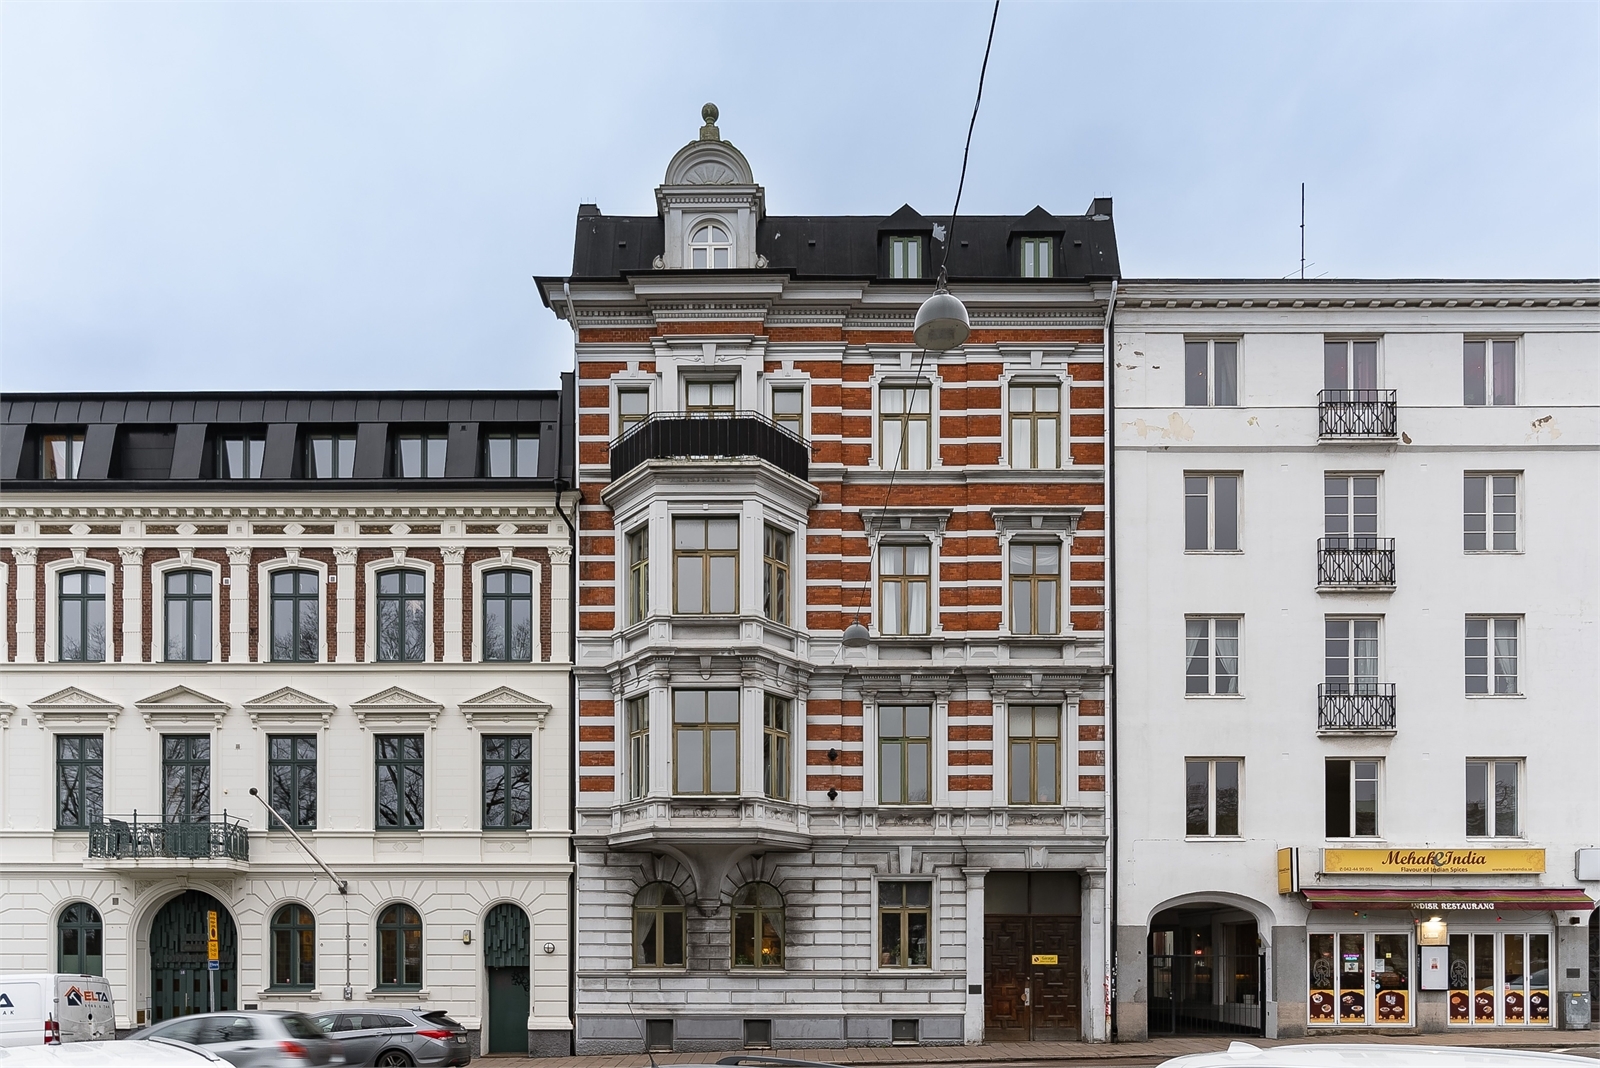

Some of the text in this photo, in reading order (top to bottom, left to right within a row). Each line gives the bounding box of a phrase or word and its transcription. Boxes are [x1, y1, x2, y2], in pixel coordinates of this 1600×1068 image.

[1382, 850, 1435, 865] Mehak
[1445, 850, 1487, 865] India
[1430, 866, 1449, 874] Indian
[1449, 866, 1469, 874] Spices
[1440, 902, 1495, 910] RESTAURANG
[83, 991, 109, 1002] ELTA
